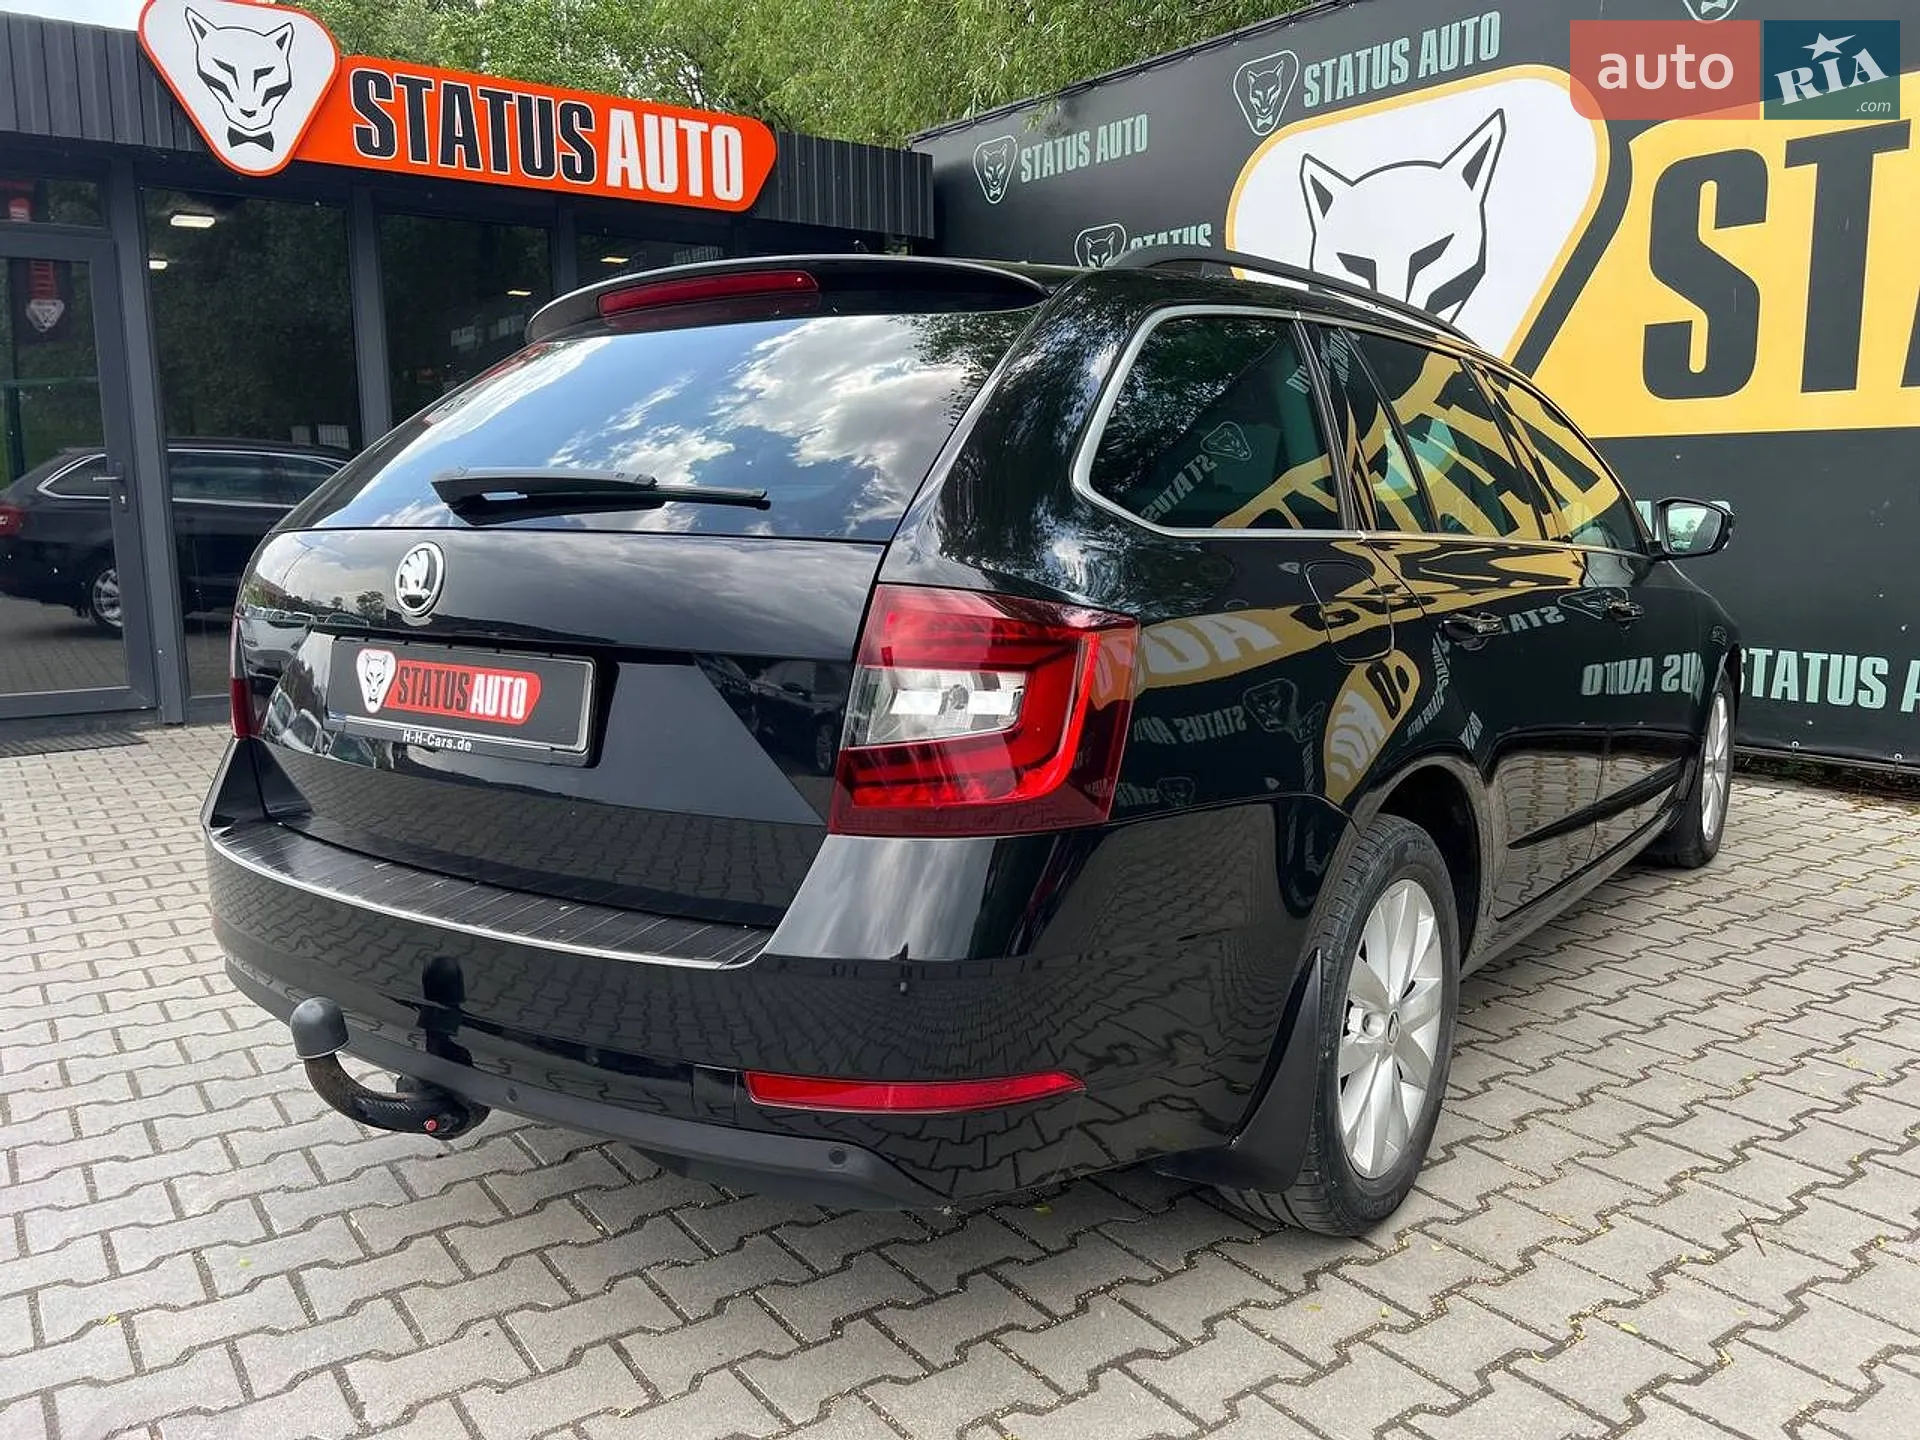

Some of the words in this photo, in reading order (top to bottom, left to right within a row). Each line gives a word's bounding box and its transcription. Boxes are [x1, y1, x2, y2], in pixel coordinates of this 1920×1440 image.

[1303, 38, 1409, 108] STATUS
[1417, 11, 1501, 79] AUTO
[350, 68, 597, 185] STATUS
[606, 108, 743, 202] AUTO
[1021, 130, 1090, 183] STATUS
[1096, 114, 1148, 165] AUTO
[399, 666, 471, 712] STATUS
[470, 673, 528, 719] AUTO
[1740, 648, 1889, 710] TATUS
[403, 729, 472, 752] H-H-Cars.de
